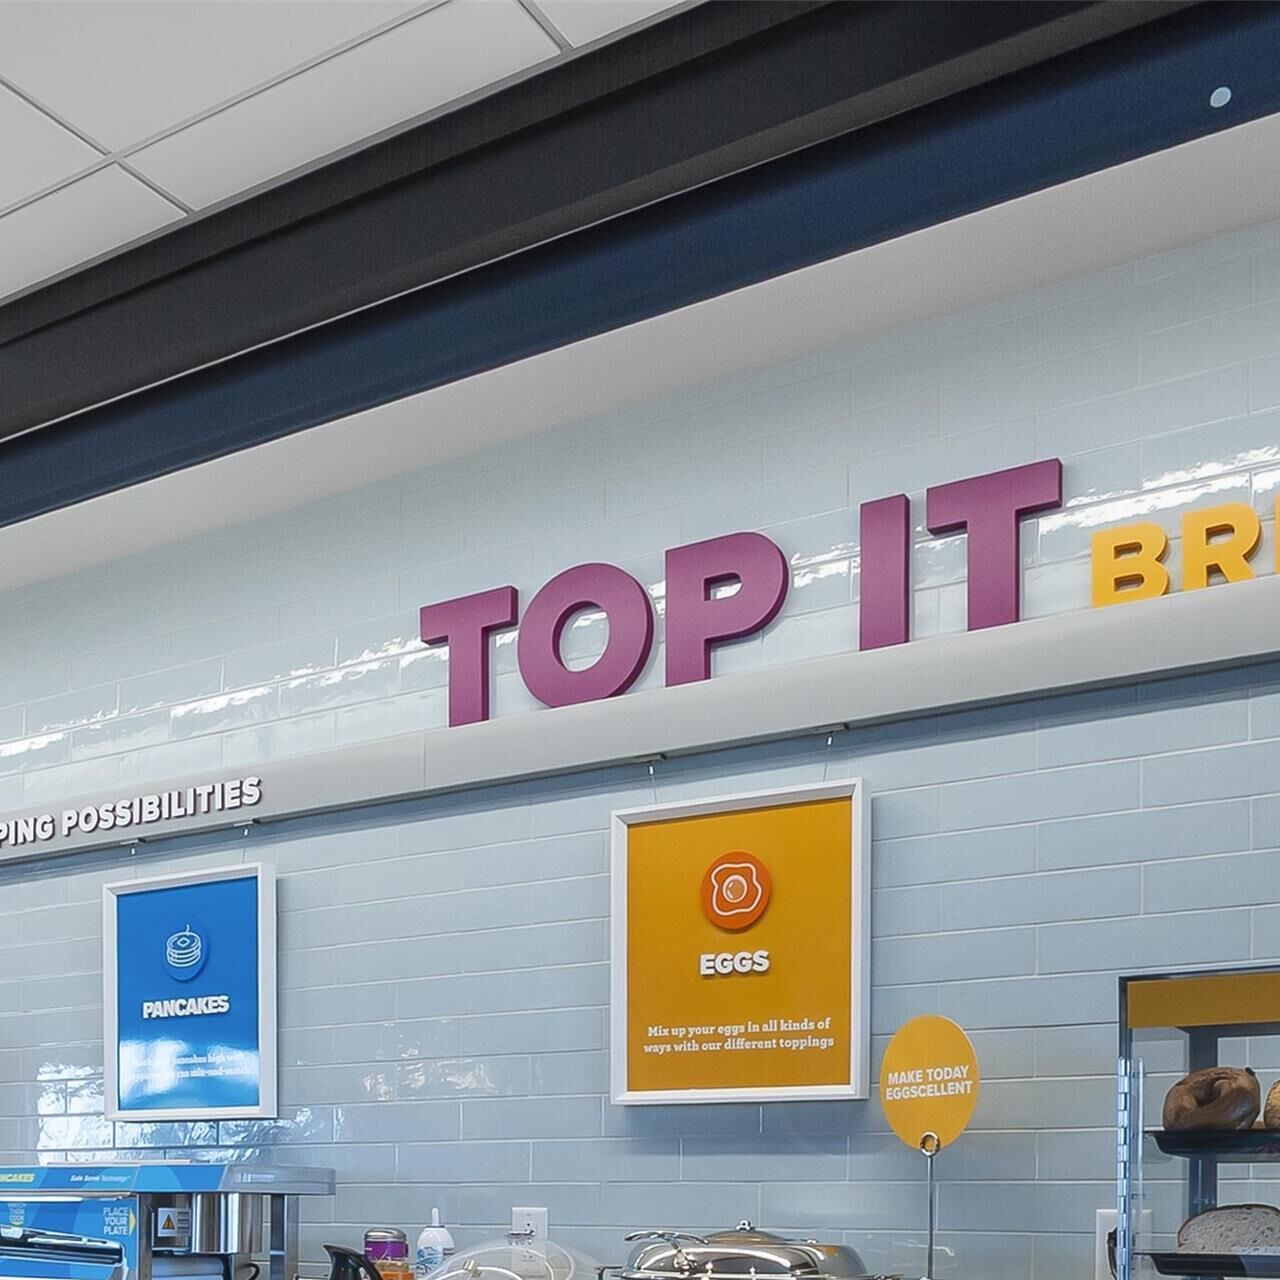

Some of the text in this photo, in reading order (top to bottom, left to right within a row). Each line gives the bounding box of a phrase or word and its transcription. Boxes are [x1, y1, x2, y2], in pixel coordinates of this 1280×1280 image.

[420, 531, 788, 727] TOP
[858, 457, 1063, 652] IT
[62, 776, 263, 837] POSSIBILITIES
[699, 949, 771, 977] EGGS
[142, 995, 231, 1019] PANCAKES
[647, 1017, 832, 1038] Mix up your eggs in all kinds of
[643, 1035, 835, 1054] ways with our different toppings
[887, 1065, 970, 1085] MAKE TODAY
[885, 1080, 973, 1100] EGGSCELLENT
[103, 1206, 129, 1216] PLACE
[104, 1216, 128, 1226] YOUR
[103, 1225, 129, 1236] PLATE
